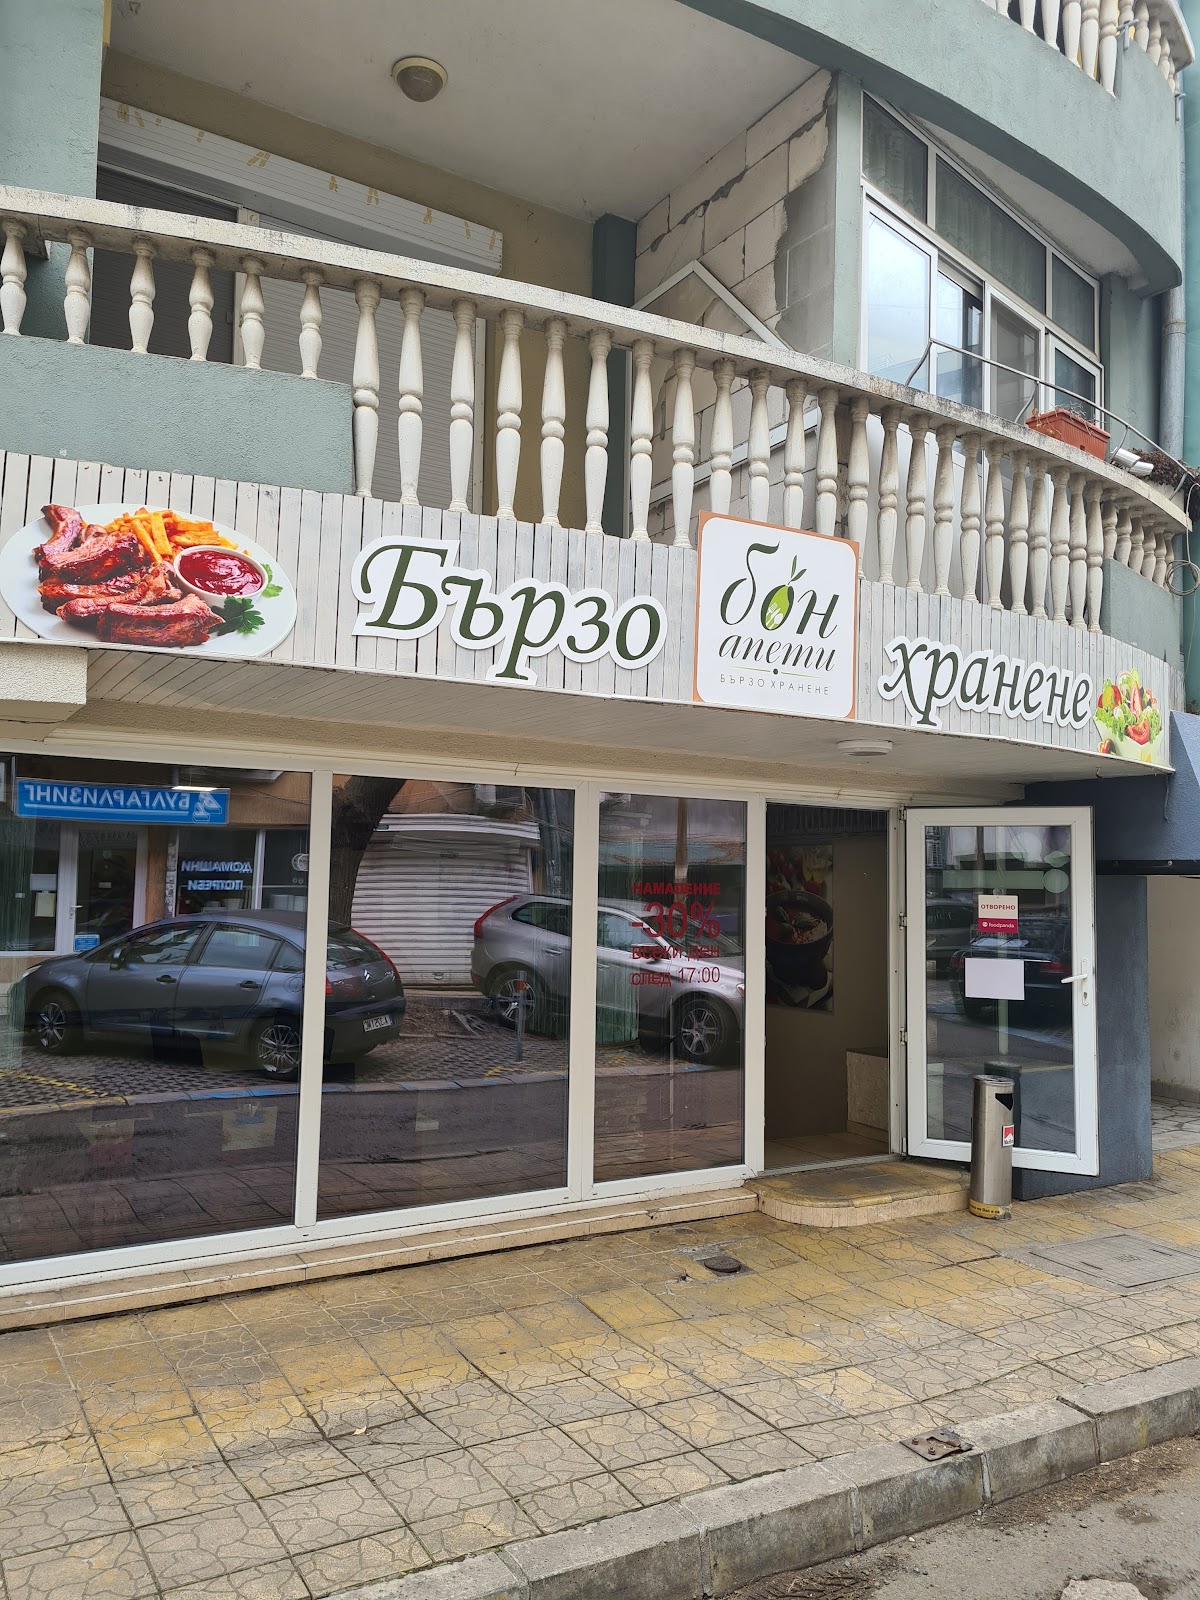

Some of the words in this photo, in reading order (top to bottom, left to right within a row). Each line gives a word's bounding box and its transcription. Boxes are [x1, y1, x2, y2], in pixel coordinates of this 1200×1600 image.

[719, 541, 840, 638] бон
[361, 545, 660, 680] Бързо
[718, 635, 836, 672] апети
[720, 673, 765, 688] БЪРЗО
[770, 679, 829, 696] ХРАНЕНЕ
[883, 642, 1090, 727] хранене
[632, 882, 721, 895] НАМАЛЕНИЕ
[631, 901, 721, 939] -30%
[631, 945, 683, 960] всеки
[688, 945, 720, 961] ден
[631, 972, 671, 987] след
[679, 966, 721, 984] 17:00
